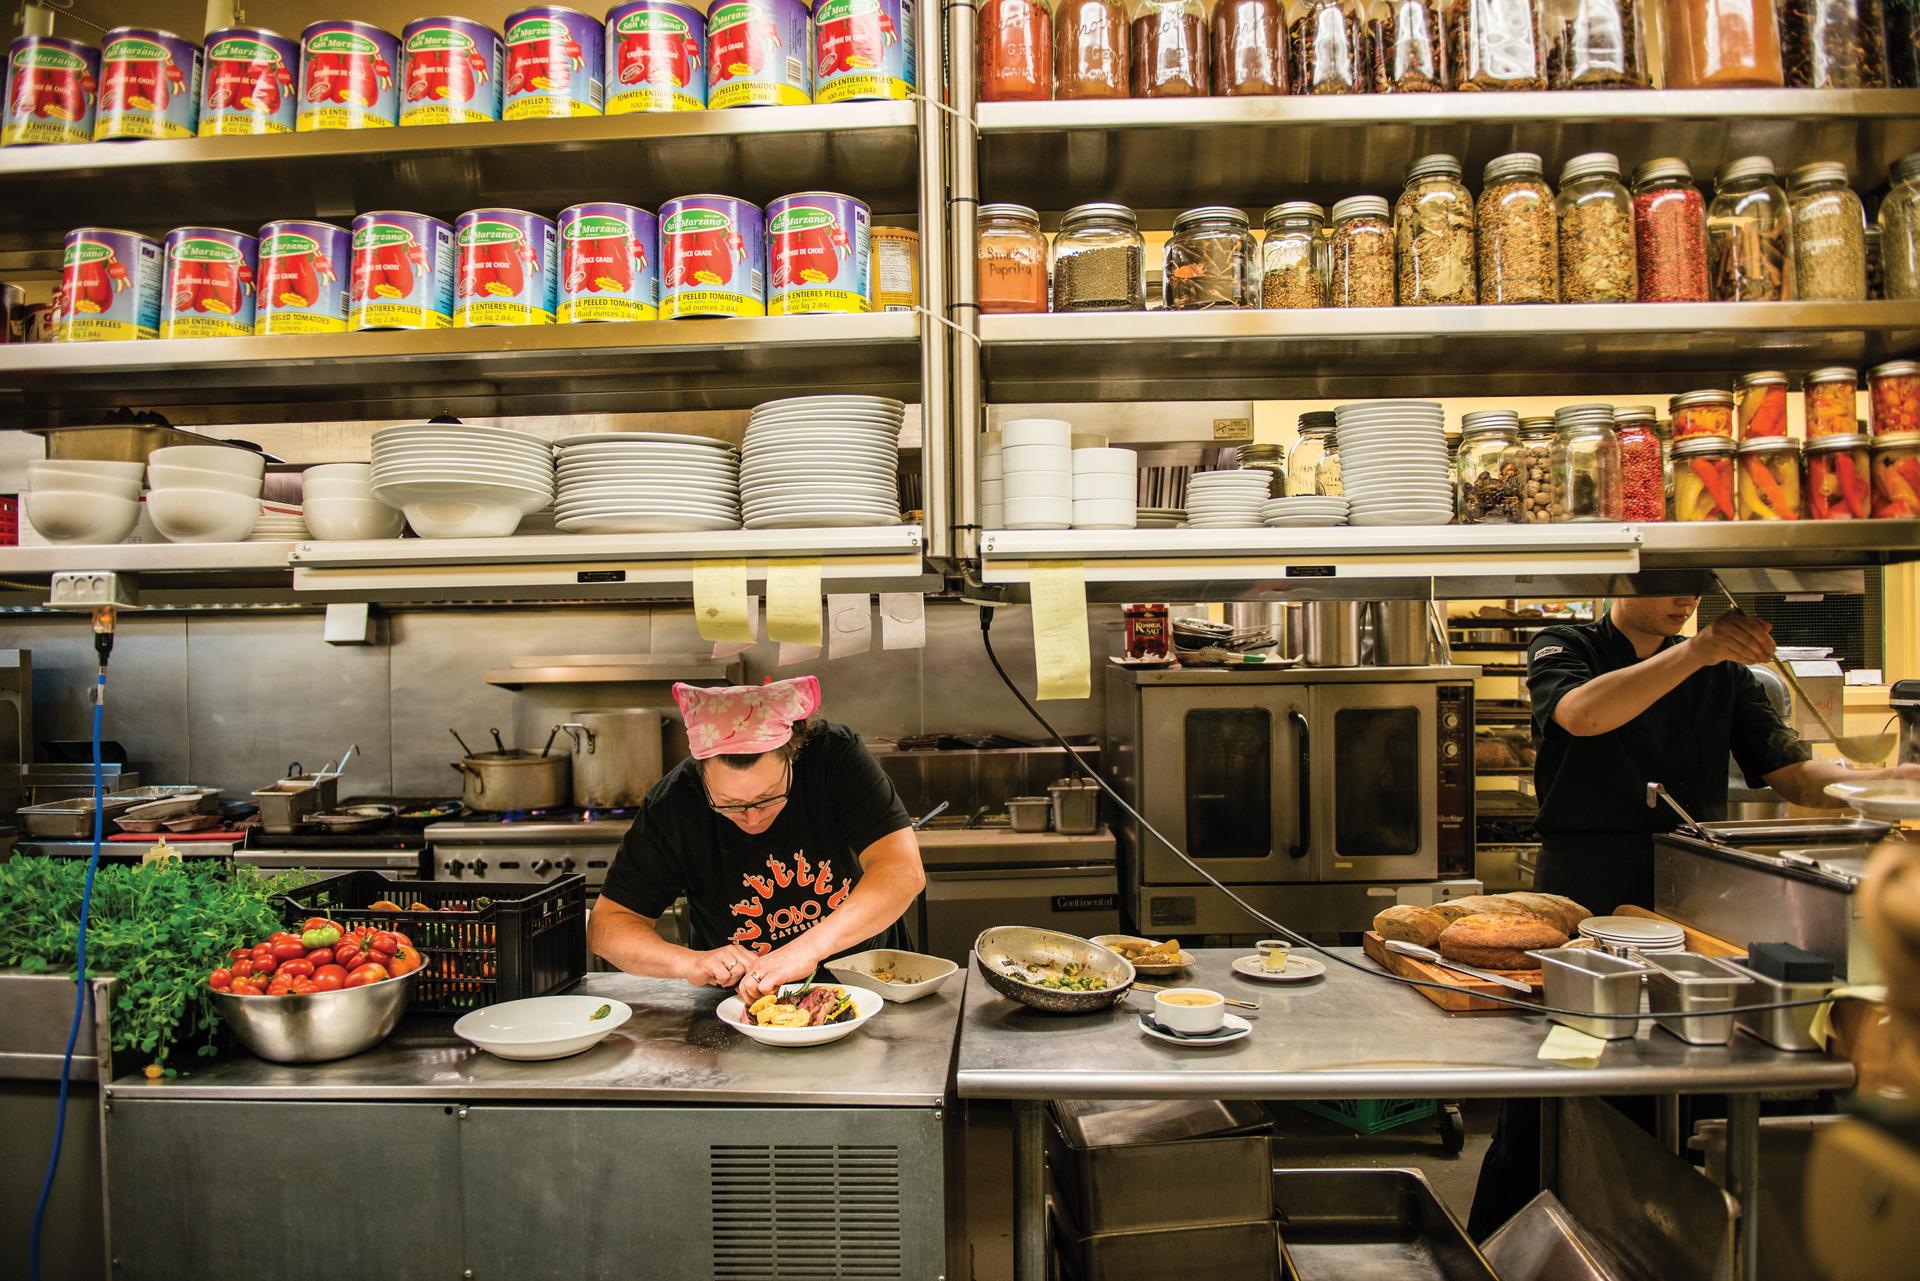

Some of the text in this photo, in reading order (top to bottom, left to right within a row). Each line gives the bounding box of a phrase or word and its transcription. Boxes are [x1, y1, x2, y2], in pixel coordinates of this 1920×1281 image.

[623, 22, 638, 30] San
[838, 76, 868, 86] ENTIERES
[720, 82, 776, 95] PEELED TOMATOES
[520, 98, 543, 106] PEELED
[617, 90, 698, 106] TOMATES PELEES
[191, 248, 233, 258] Marzano
[989, 262, 1032, 280] Paprika
[709, 293, 743, 303] TOMATOES
[509, 304, 532, 313] PELEES
[611, 299, 643, 310] TOMATOES
[397, 306, 422, 314] PELEES
[294, 314, 330, 324] TOMATOES
[1057, 896, 1112, 908] Continental
[766, 900, 821, 932] SOBO
